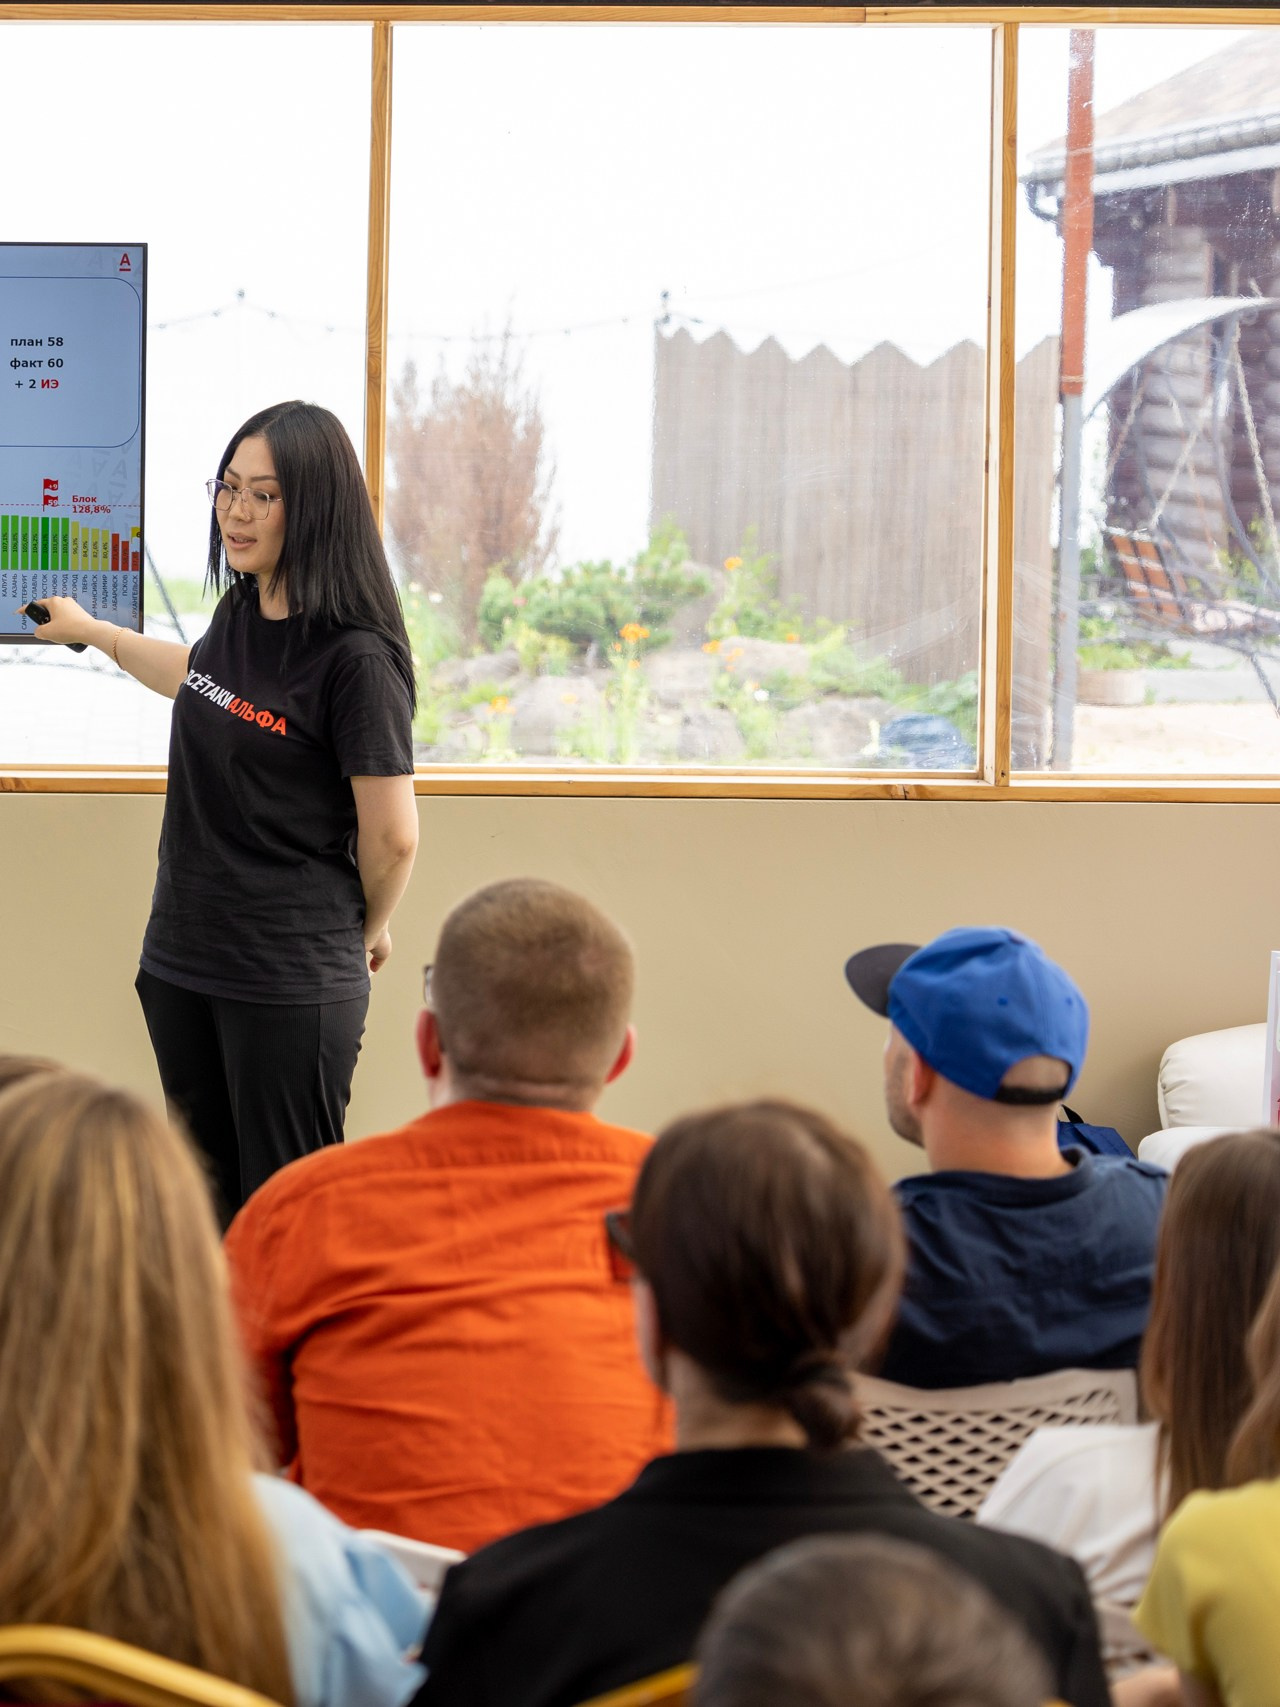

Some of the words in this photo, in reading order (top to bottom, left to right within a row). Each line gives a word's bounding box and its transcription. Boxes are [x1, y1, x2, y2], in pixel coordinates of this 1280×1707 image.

[10, 337, 42, 348] план
[48, 336, 63, 347] 58
[9, 358, 43, 369] факт
[48, 358, 63, 368] 60
[29, 379, 36, 388] 2
[41, 379, 59, 388] ИЭ
